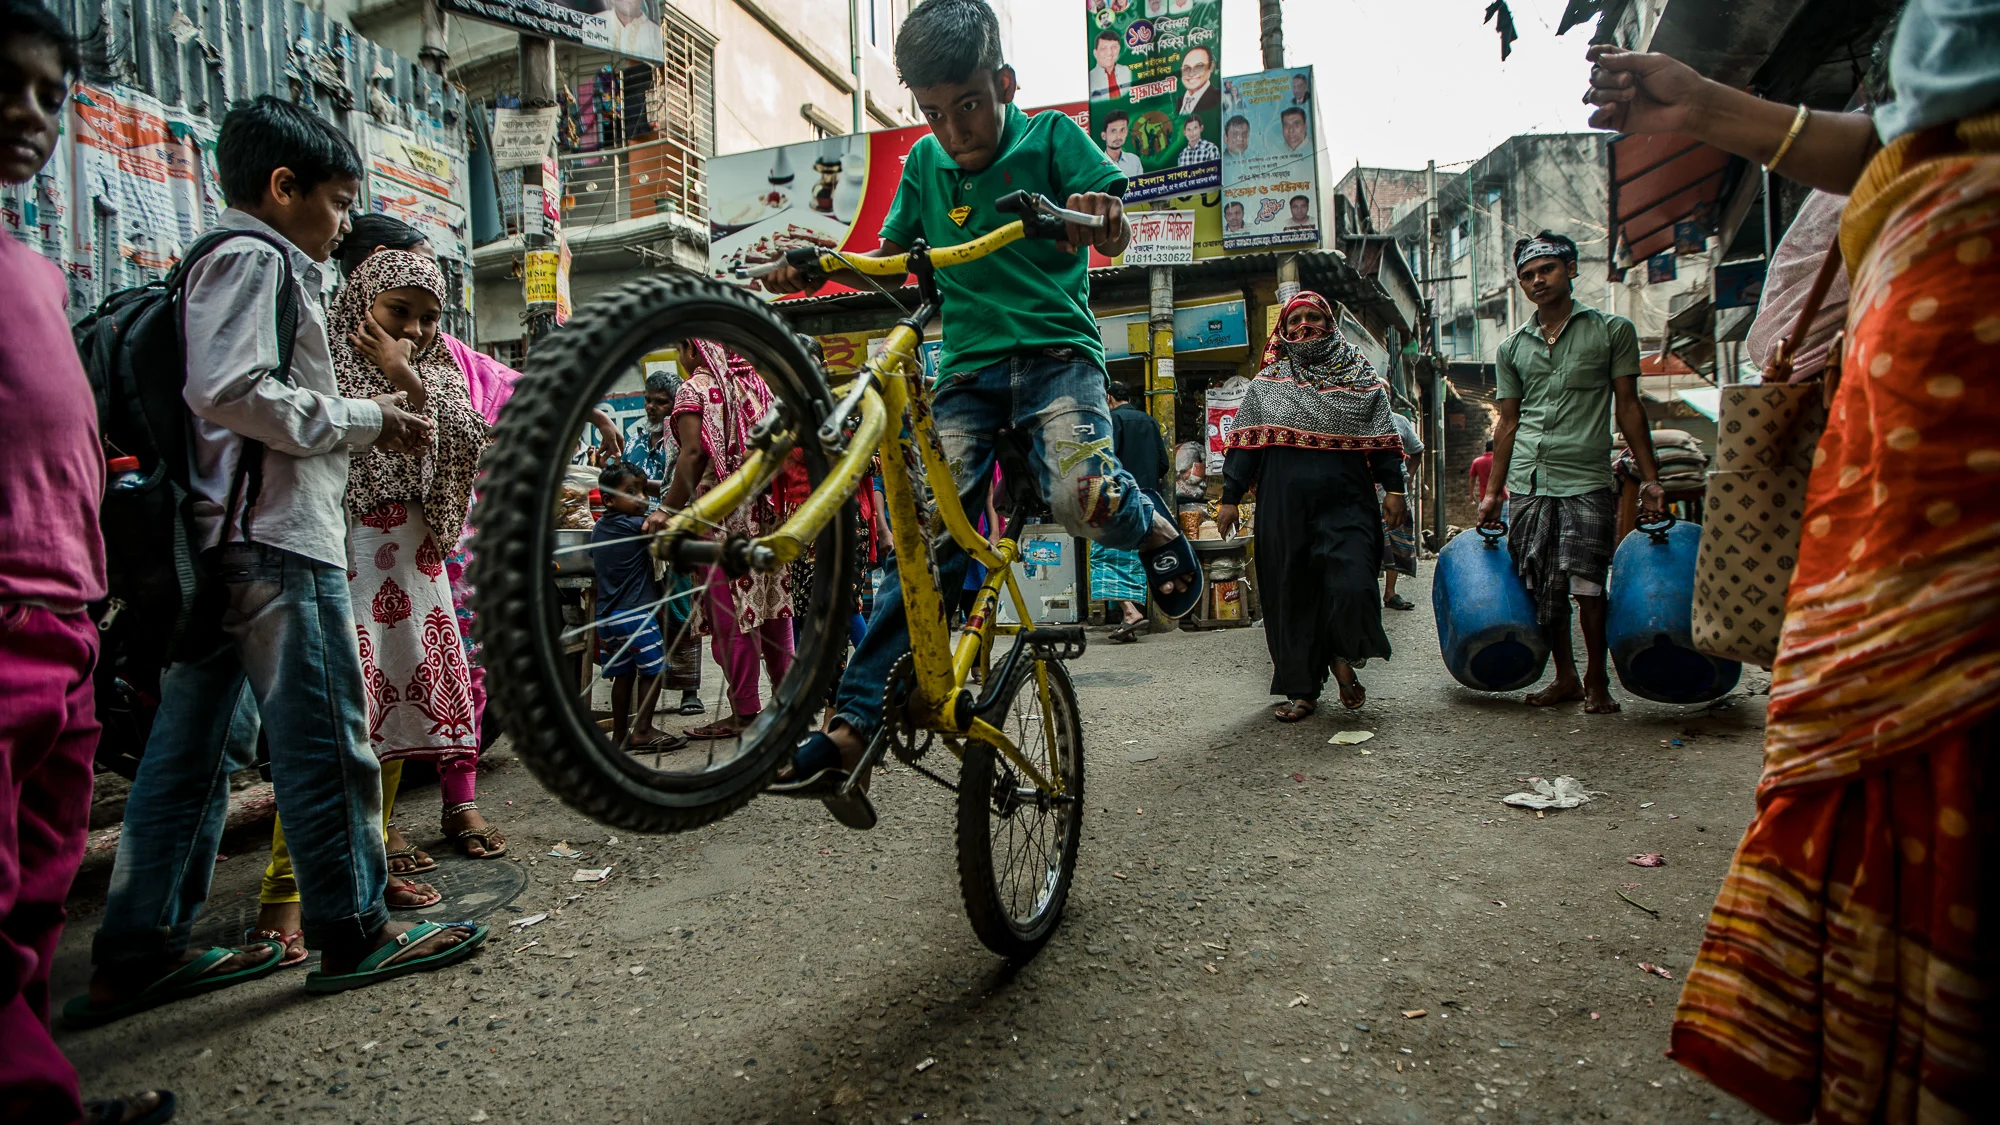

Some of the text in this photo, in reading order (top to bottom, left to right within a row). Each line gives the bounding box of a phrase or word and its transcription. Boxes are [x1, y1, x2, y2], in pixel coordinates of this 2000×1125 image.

[1128, 16, 1190, 45] ১৬ ডিসেম্বর
[1157, 33, 1185, 53] বিজয়
[1187, 26, 1213, 47] দিবস
[1137, 175, 1165, 188] ইসলাম
[1125, 252, 1192, 263] 01811-330622
